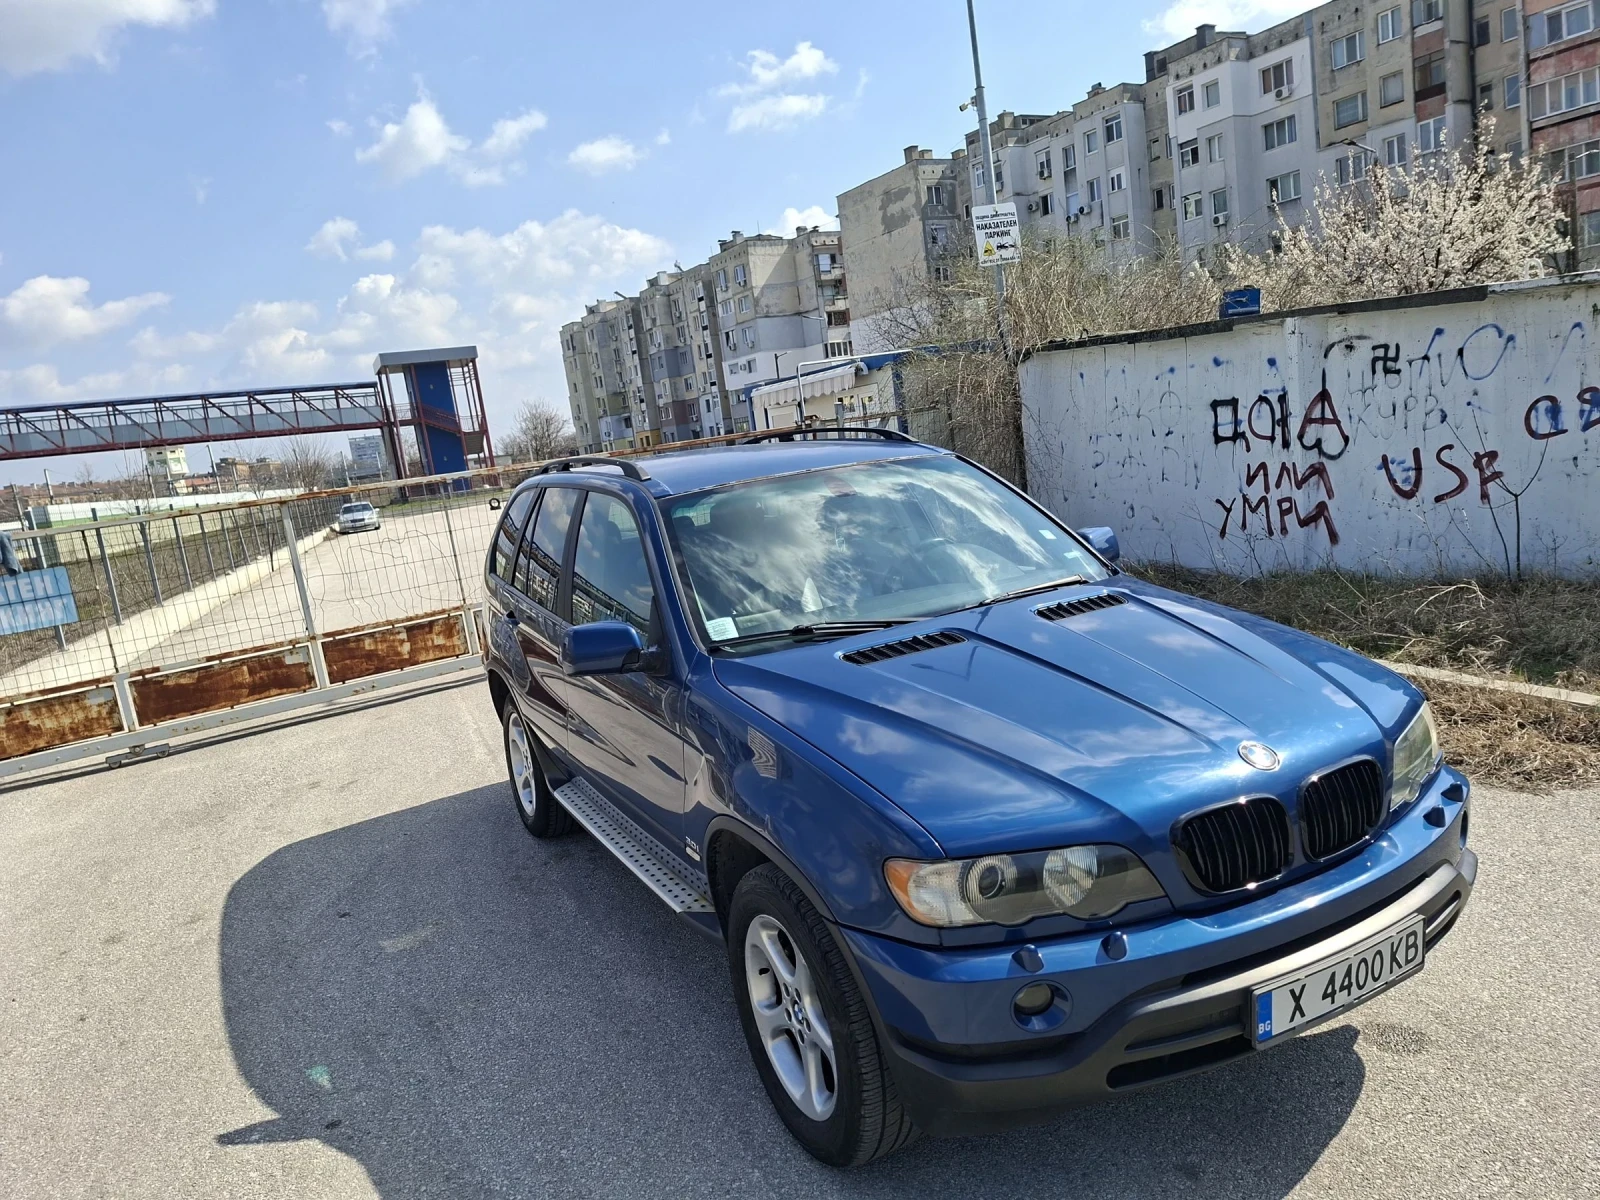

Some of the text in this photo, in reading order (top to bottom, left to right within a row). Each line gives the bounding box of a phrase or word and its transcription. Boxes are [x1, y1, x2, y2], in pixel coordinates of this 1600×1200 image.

[976, 220, 1017, 231] НАКАЗАТЕЛЕН
[984, 229, 1011, 239] ПАРКИНГ
[1288, 929, 1419, 1024] X 4400 KB
[1258, 1020, 1271, 1034] BG
